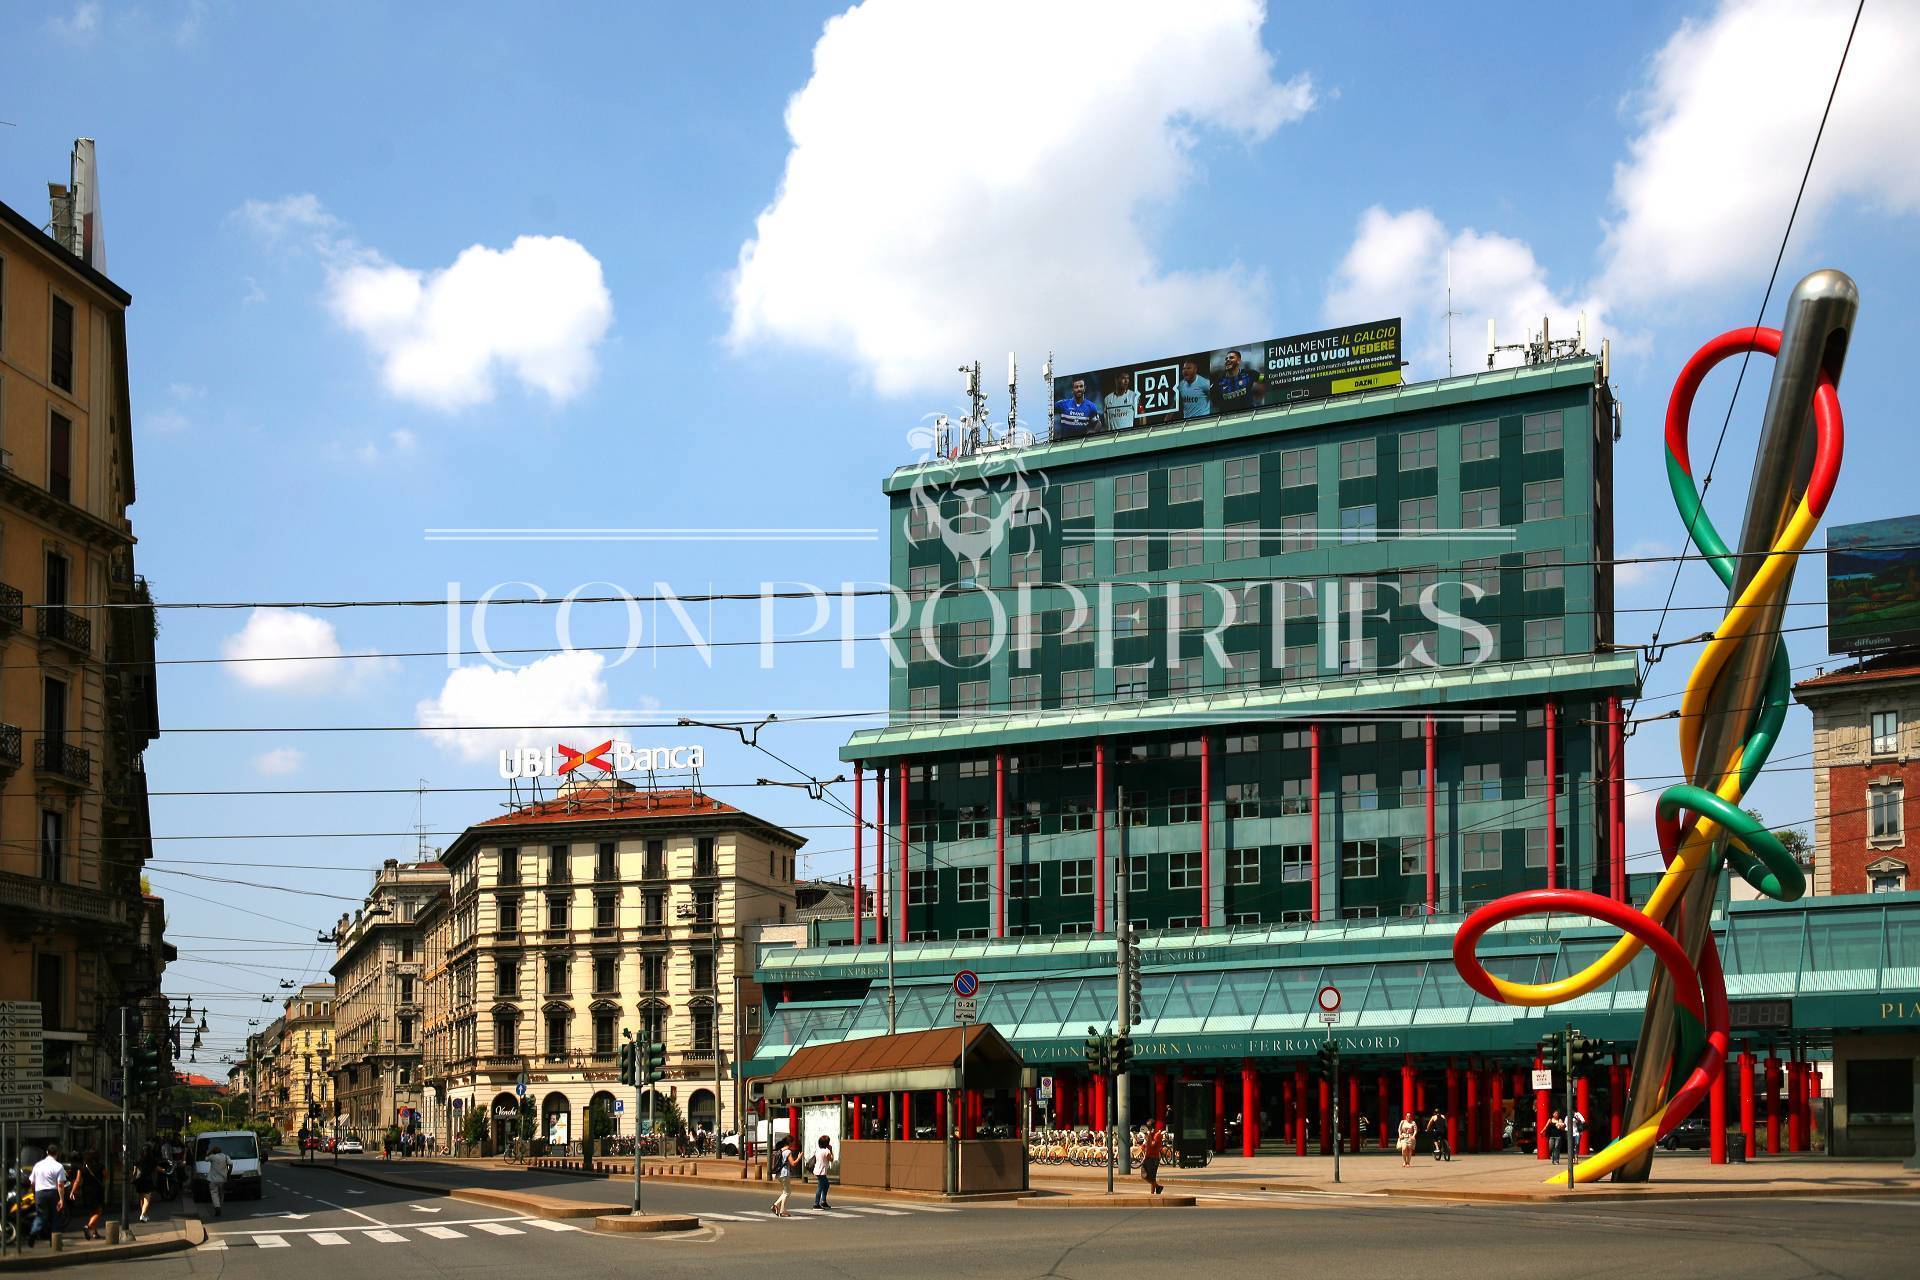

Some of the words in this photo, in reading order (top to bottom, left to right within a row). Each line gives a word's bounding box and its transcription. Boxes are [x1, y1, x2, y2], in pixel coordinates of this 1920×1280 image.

[1268, 336, 1339, 359] FINALMENTE
[1341, 334, 1351, 346] IL
[1353, 326, 1396, 343] CALCIO
[1268, 355, 1302, 370] COME
[1304, 352, 1318, 364] LO
[1320, 347, 1350, 361] VUOI
[1351, 339, 1395, 356] VEDERE
[1354, 378, 1373, 387] DAZN
[500, 745, 554, 779] UBI
[614, 740, 705, 773] Banca
[768, 969, 823, 981] MALPENSA
[840, 967, 885, 977] EXPRESS
[1019, 1045, 1086, 1059] TAZION
[1133, 1042, 1193, 1056] DORNA
[1249, 1036, 1401, 1052] FERROVENORD
[615, 1101, 622, 1111] P
